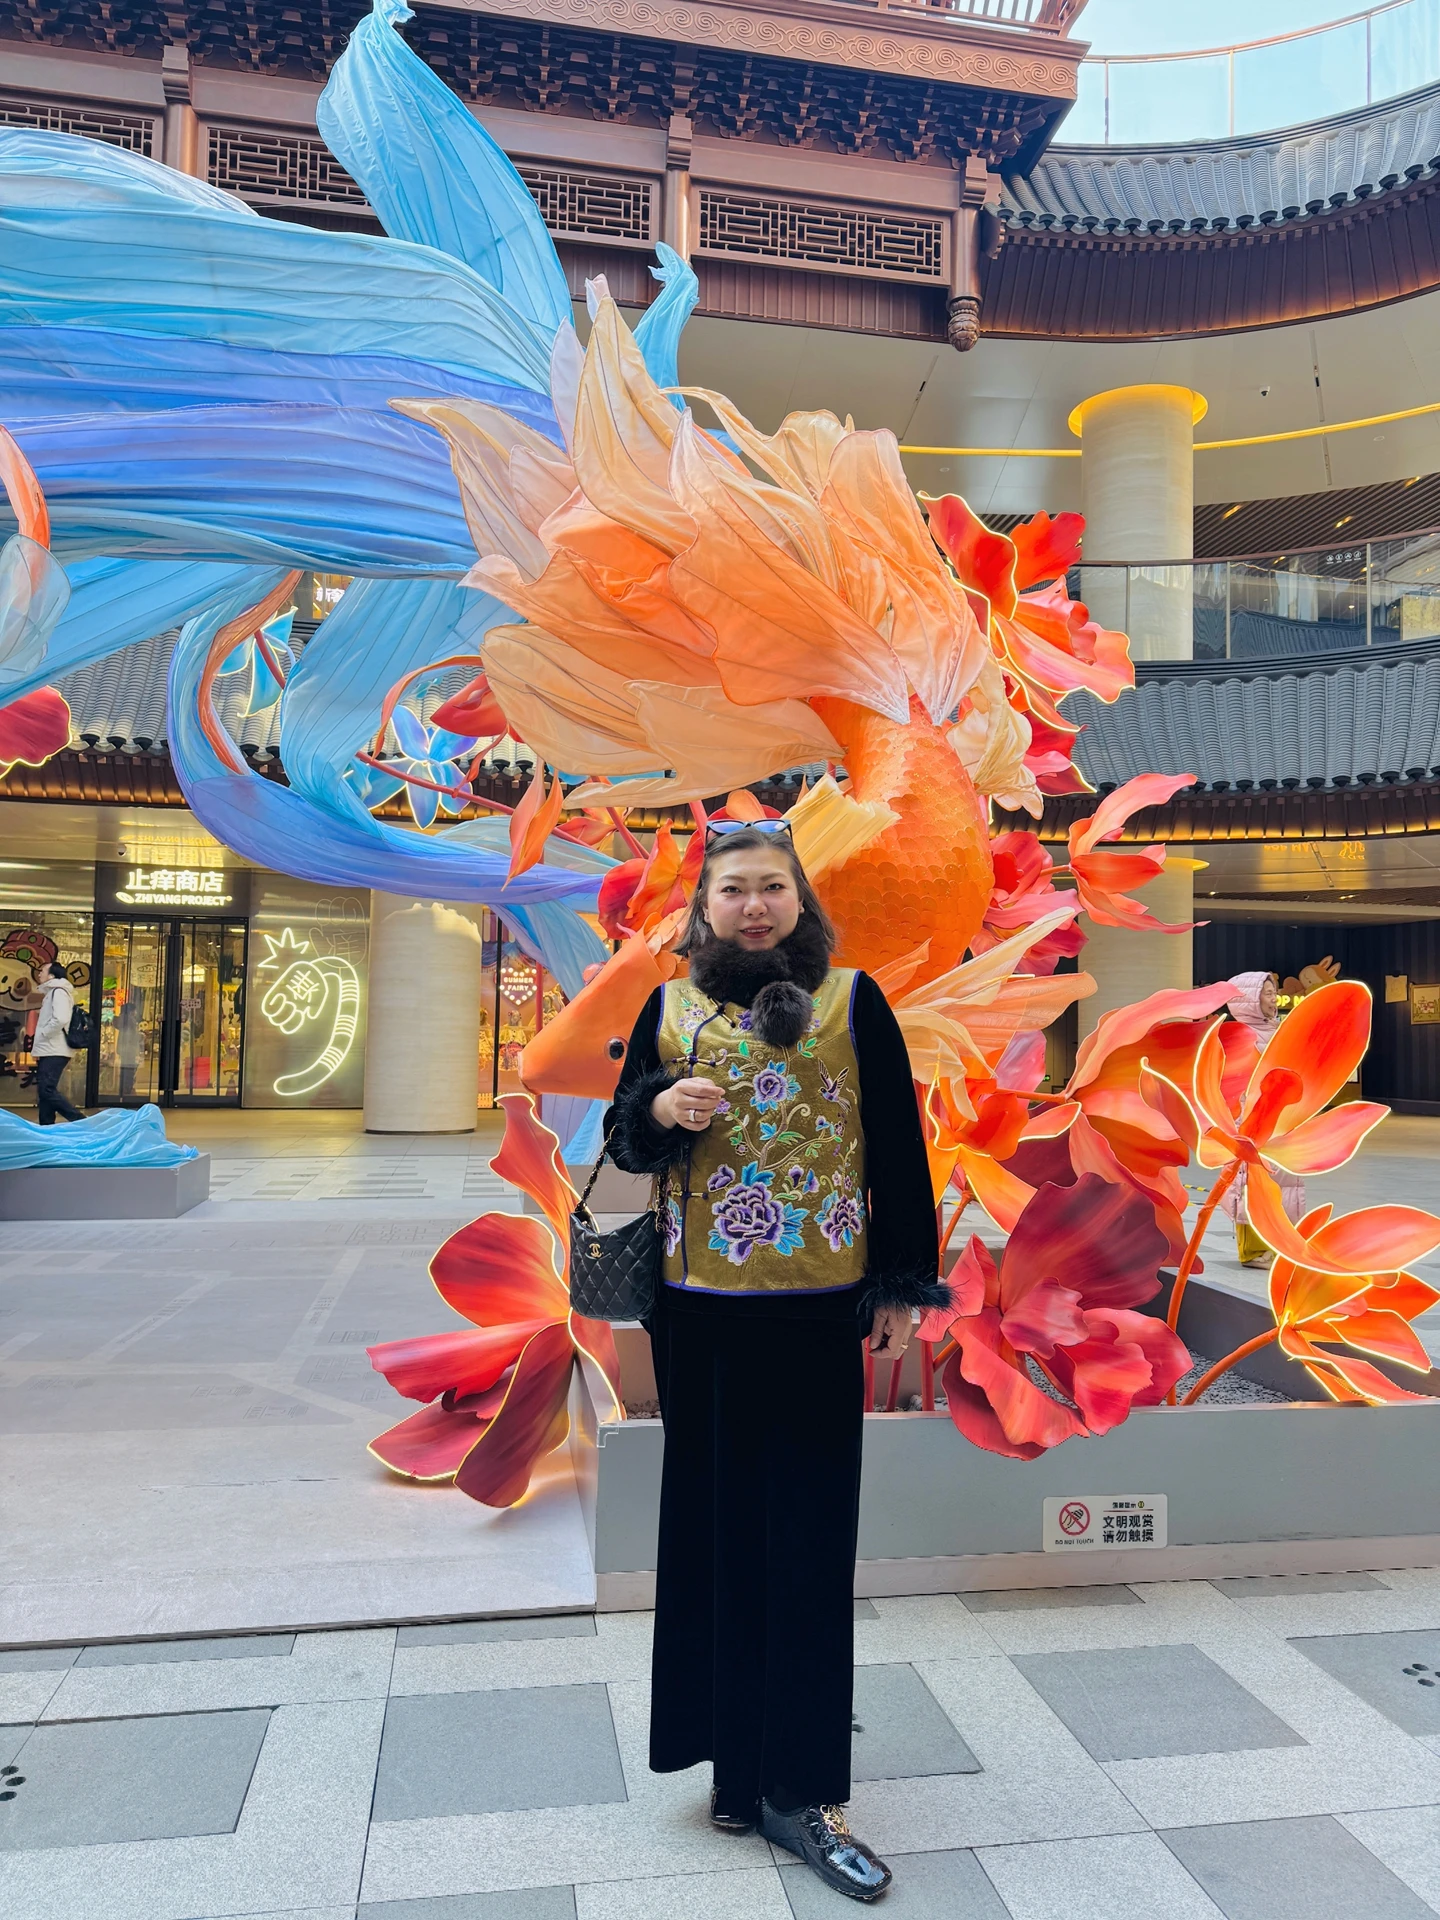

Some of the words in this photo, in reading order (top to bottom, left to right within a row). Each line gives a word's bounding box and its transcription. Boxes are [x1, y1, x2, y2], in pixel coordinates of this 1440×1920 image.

[125, 868, 224, 892] 止痒商店
[134, 893, 181, 904] ZHIYANG
[1102, 1514, 1154, 1529] 文明观赏
[1102, 1529, 1154, 1544] 请勿触摸
